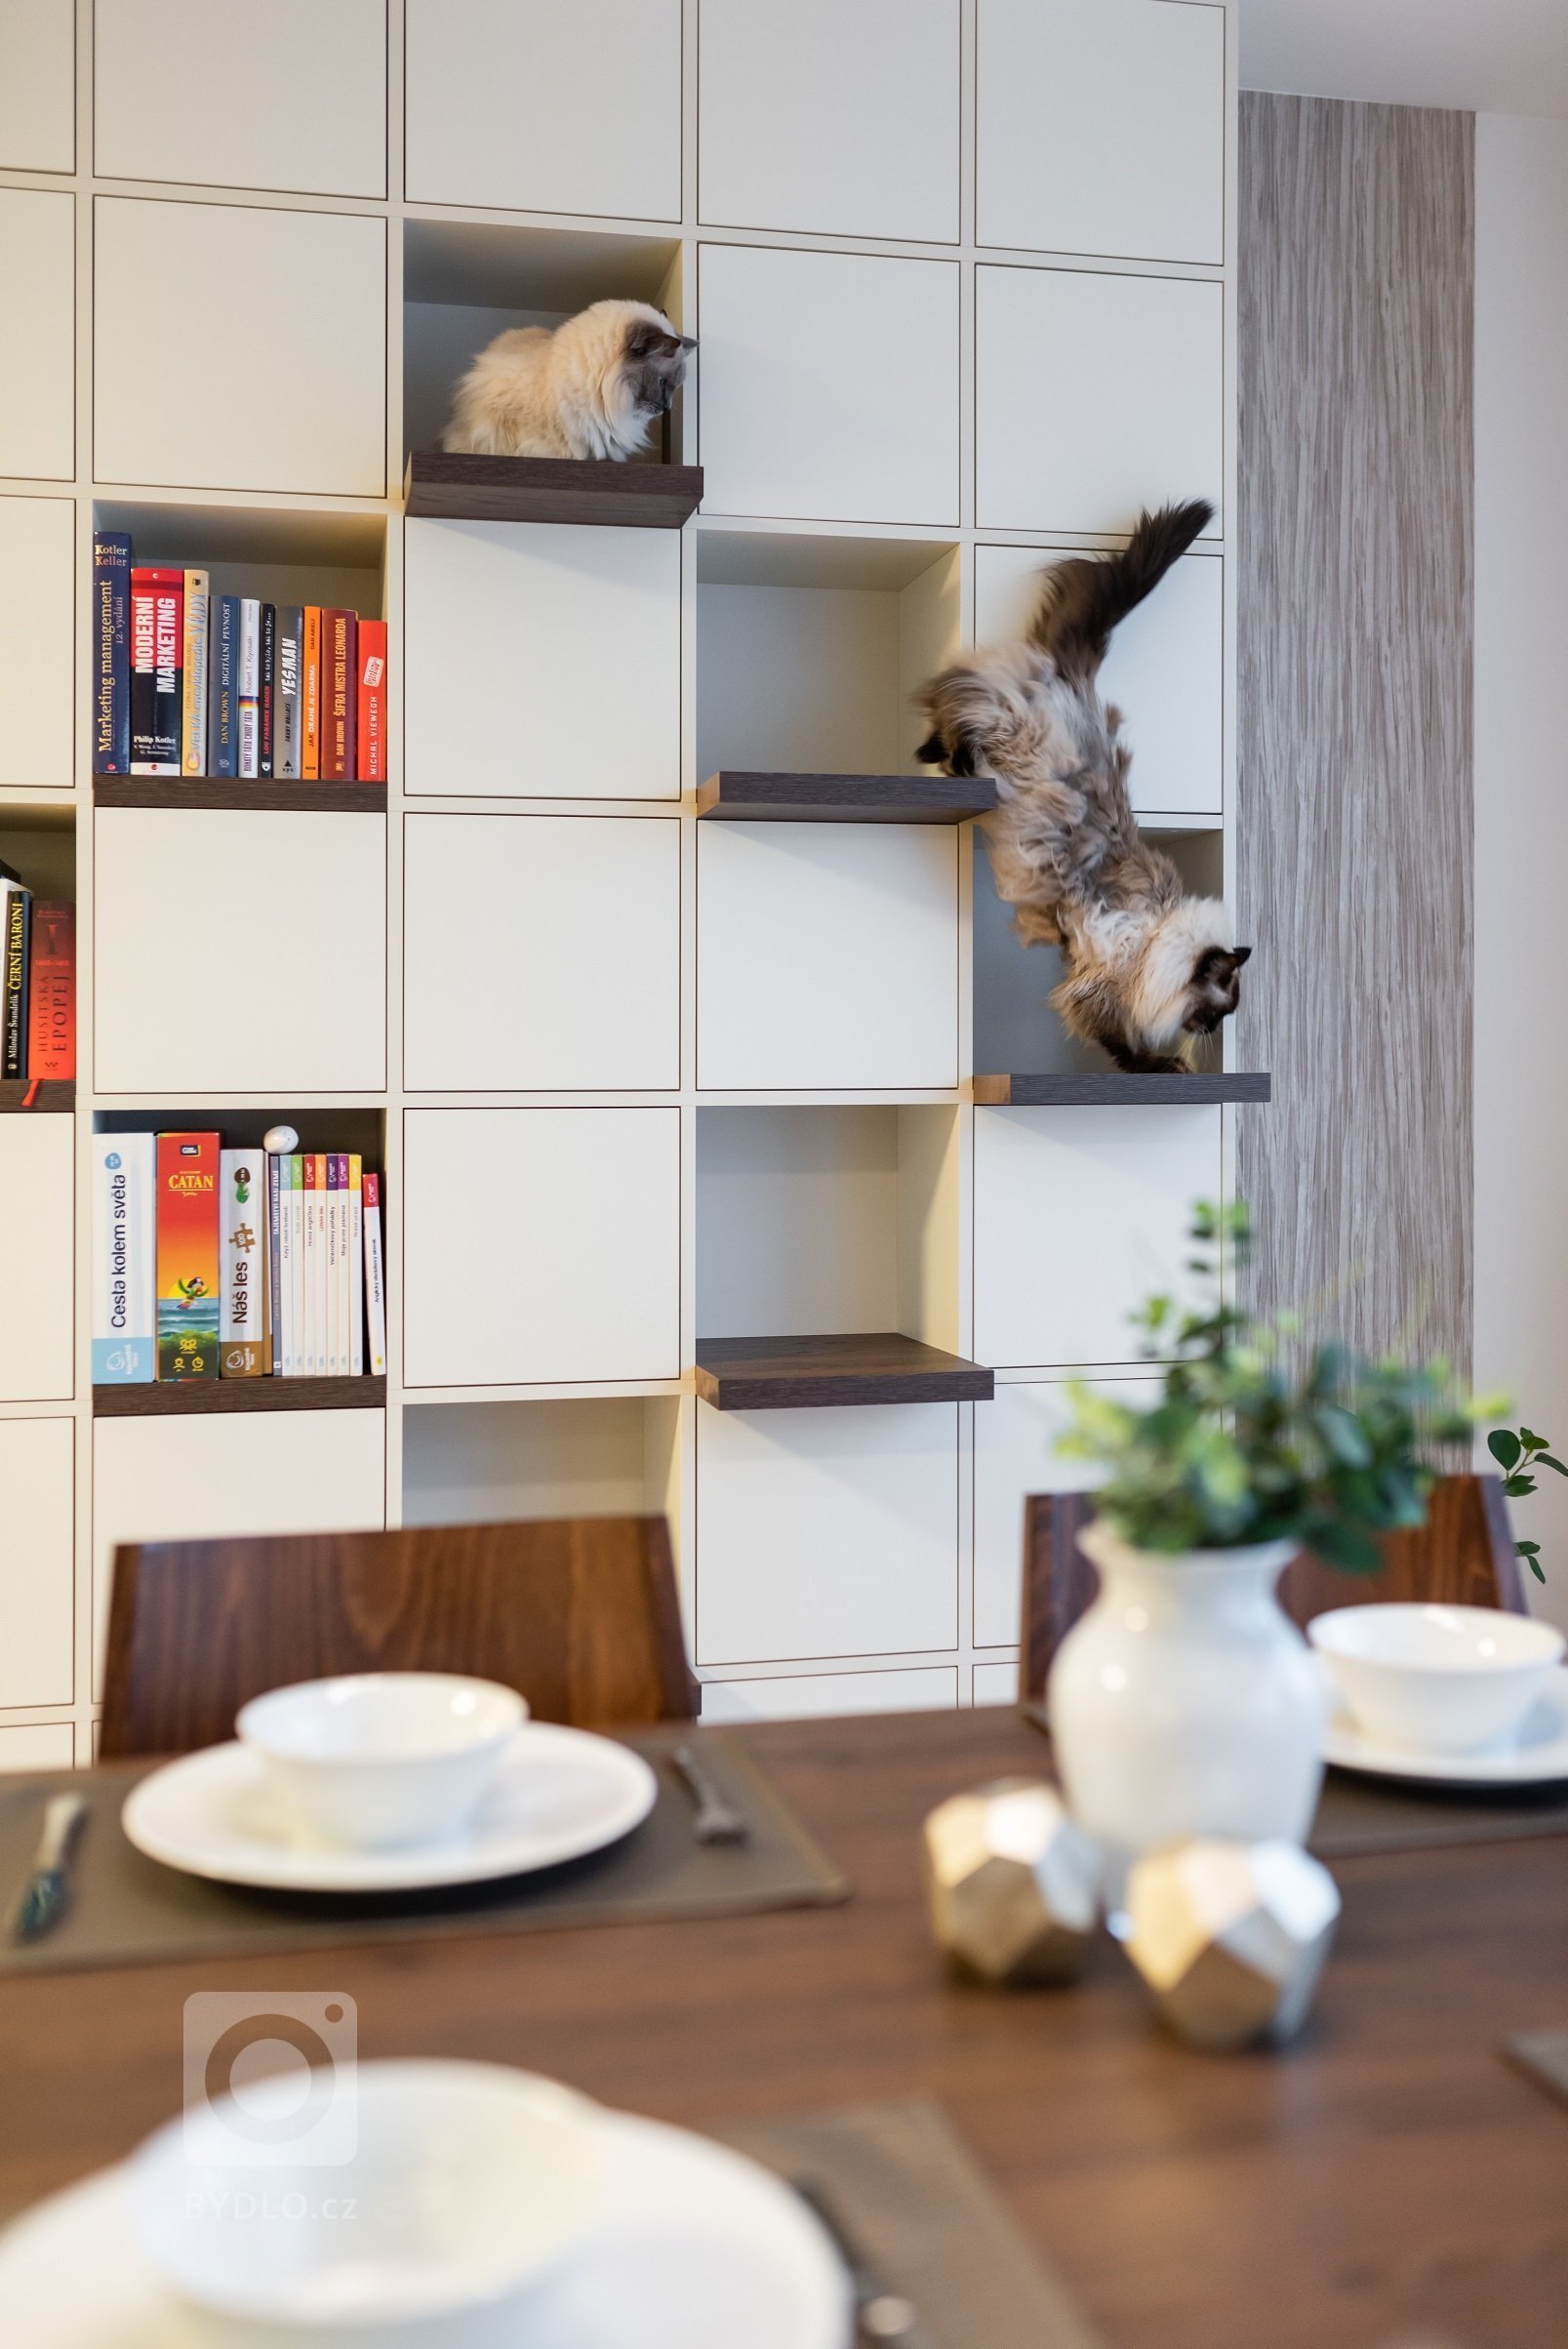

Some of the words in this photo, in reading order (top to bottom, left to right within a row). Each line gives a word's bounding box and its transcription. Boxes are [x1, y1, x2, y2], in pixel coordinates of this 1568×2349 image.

[95, 545, 127, 555] Kotler
[95, 556, 127, 566] Keller
[100, 581, 115, 673] management
[133, 596, 154, 673] MODERNÍ
[157, 597, 176, 693] MARKETING
[336, 619, 345, 660] LEONARDA
[221, 643, 230, 685] DIGITÁLNÍ
[336, 662, 345, 691] MISTRA
[98, 677, 115, 751] Marketing
[334, 694, 345, 716] ŠIFRA
[11, 904, 23, 949] BARONI
[8, 952, 21, 990] ČERNÍ
[53, 977, 70, 1050] EPOPEJ
[8, 1030, 18, 1058] Miloslav
[111, 1175, 126, 1218] světa
[168, 1175, 214, 1189] CATAN
[111, 1225, 125, 1275] kolem
[237, 1233, 246, 1245] 100
[233, 1261, 248, 1286] les
[111, 1280, 126, 1327] Cesta
[232, 1291, 248, 1323] Náš
